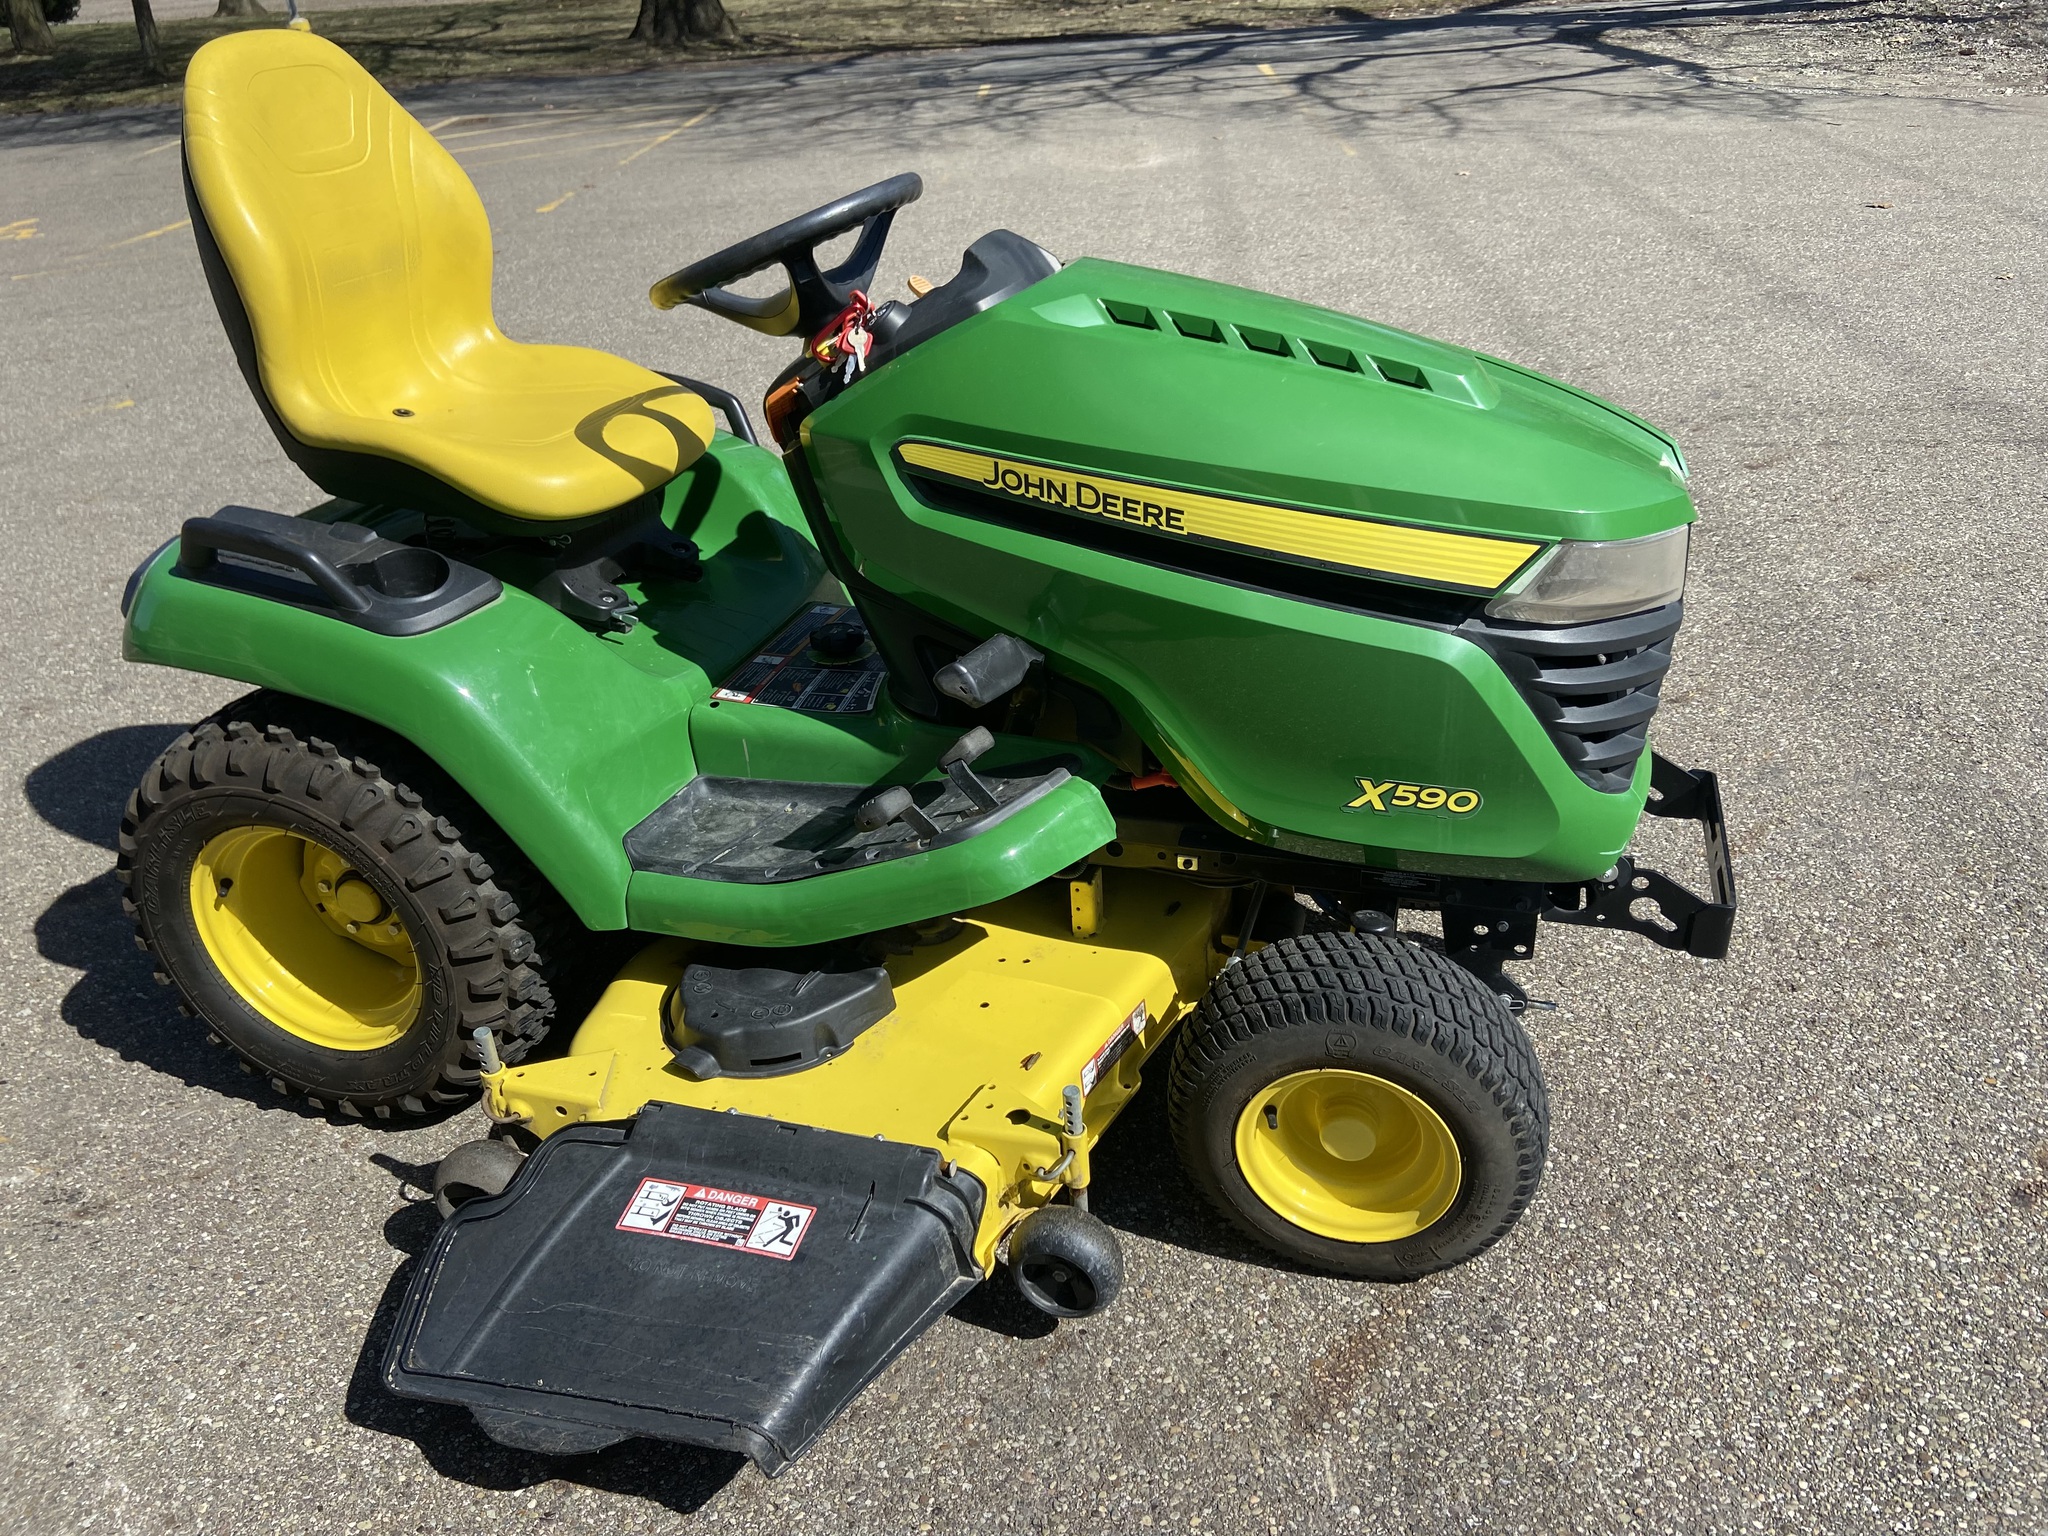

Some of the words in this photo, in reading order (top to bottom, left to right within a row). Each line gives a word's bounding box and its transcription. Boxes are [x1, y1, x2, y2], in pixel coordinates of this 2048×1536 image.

[982, 461, 1068, 505] JOHN
[1075, 481, 1187, 534] DEERE
[1346, 778, 1480, 814] X590
[143, 800, 212, 915] CARLISLE
[1372, 1046, 1482, 1114] CARLISLE
[694, 1199, 726, 1209] ROTATING
[726, 1205, 748, 1213] BLADE
[707, 1190, 759, 1207] DANGER
[687, 1210, 715, 1219] THROWN
[714, 1215, 743, 1225] OBJECTS
